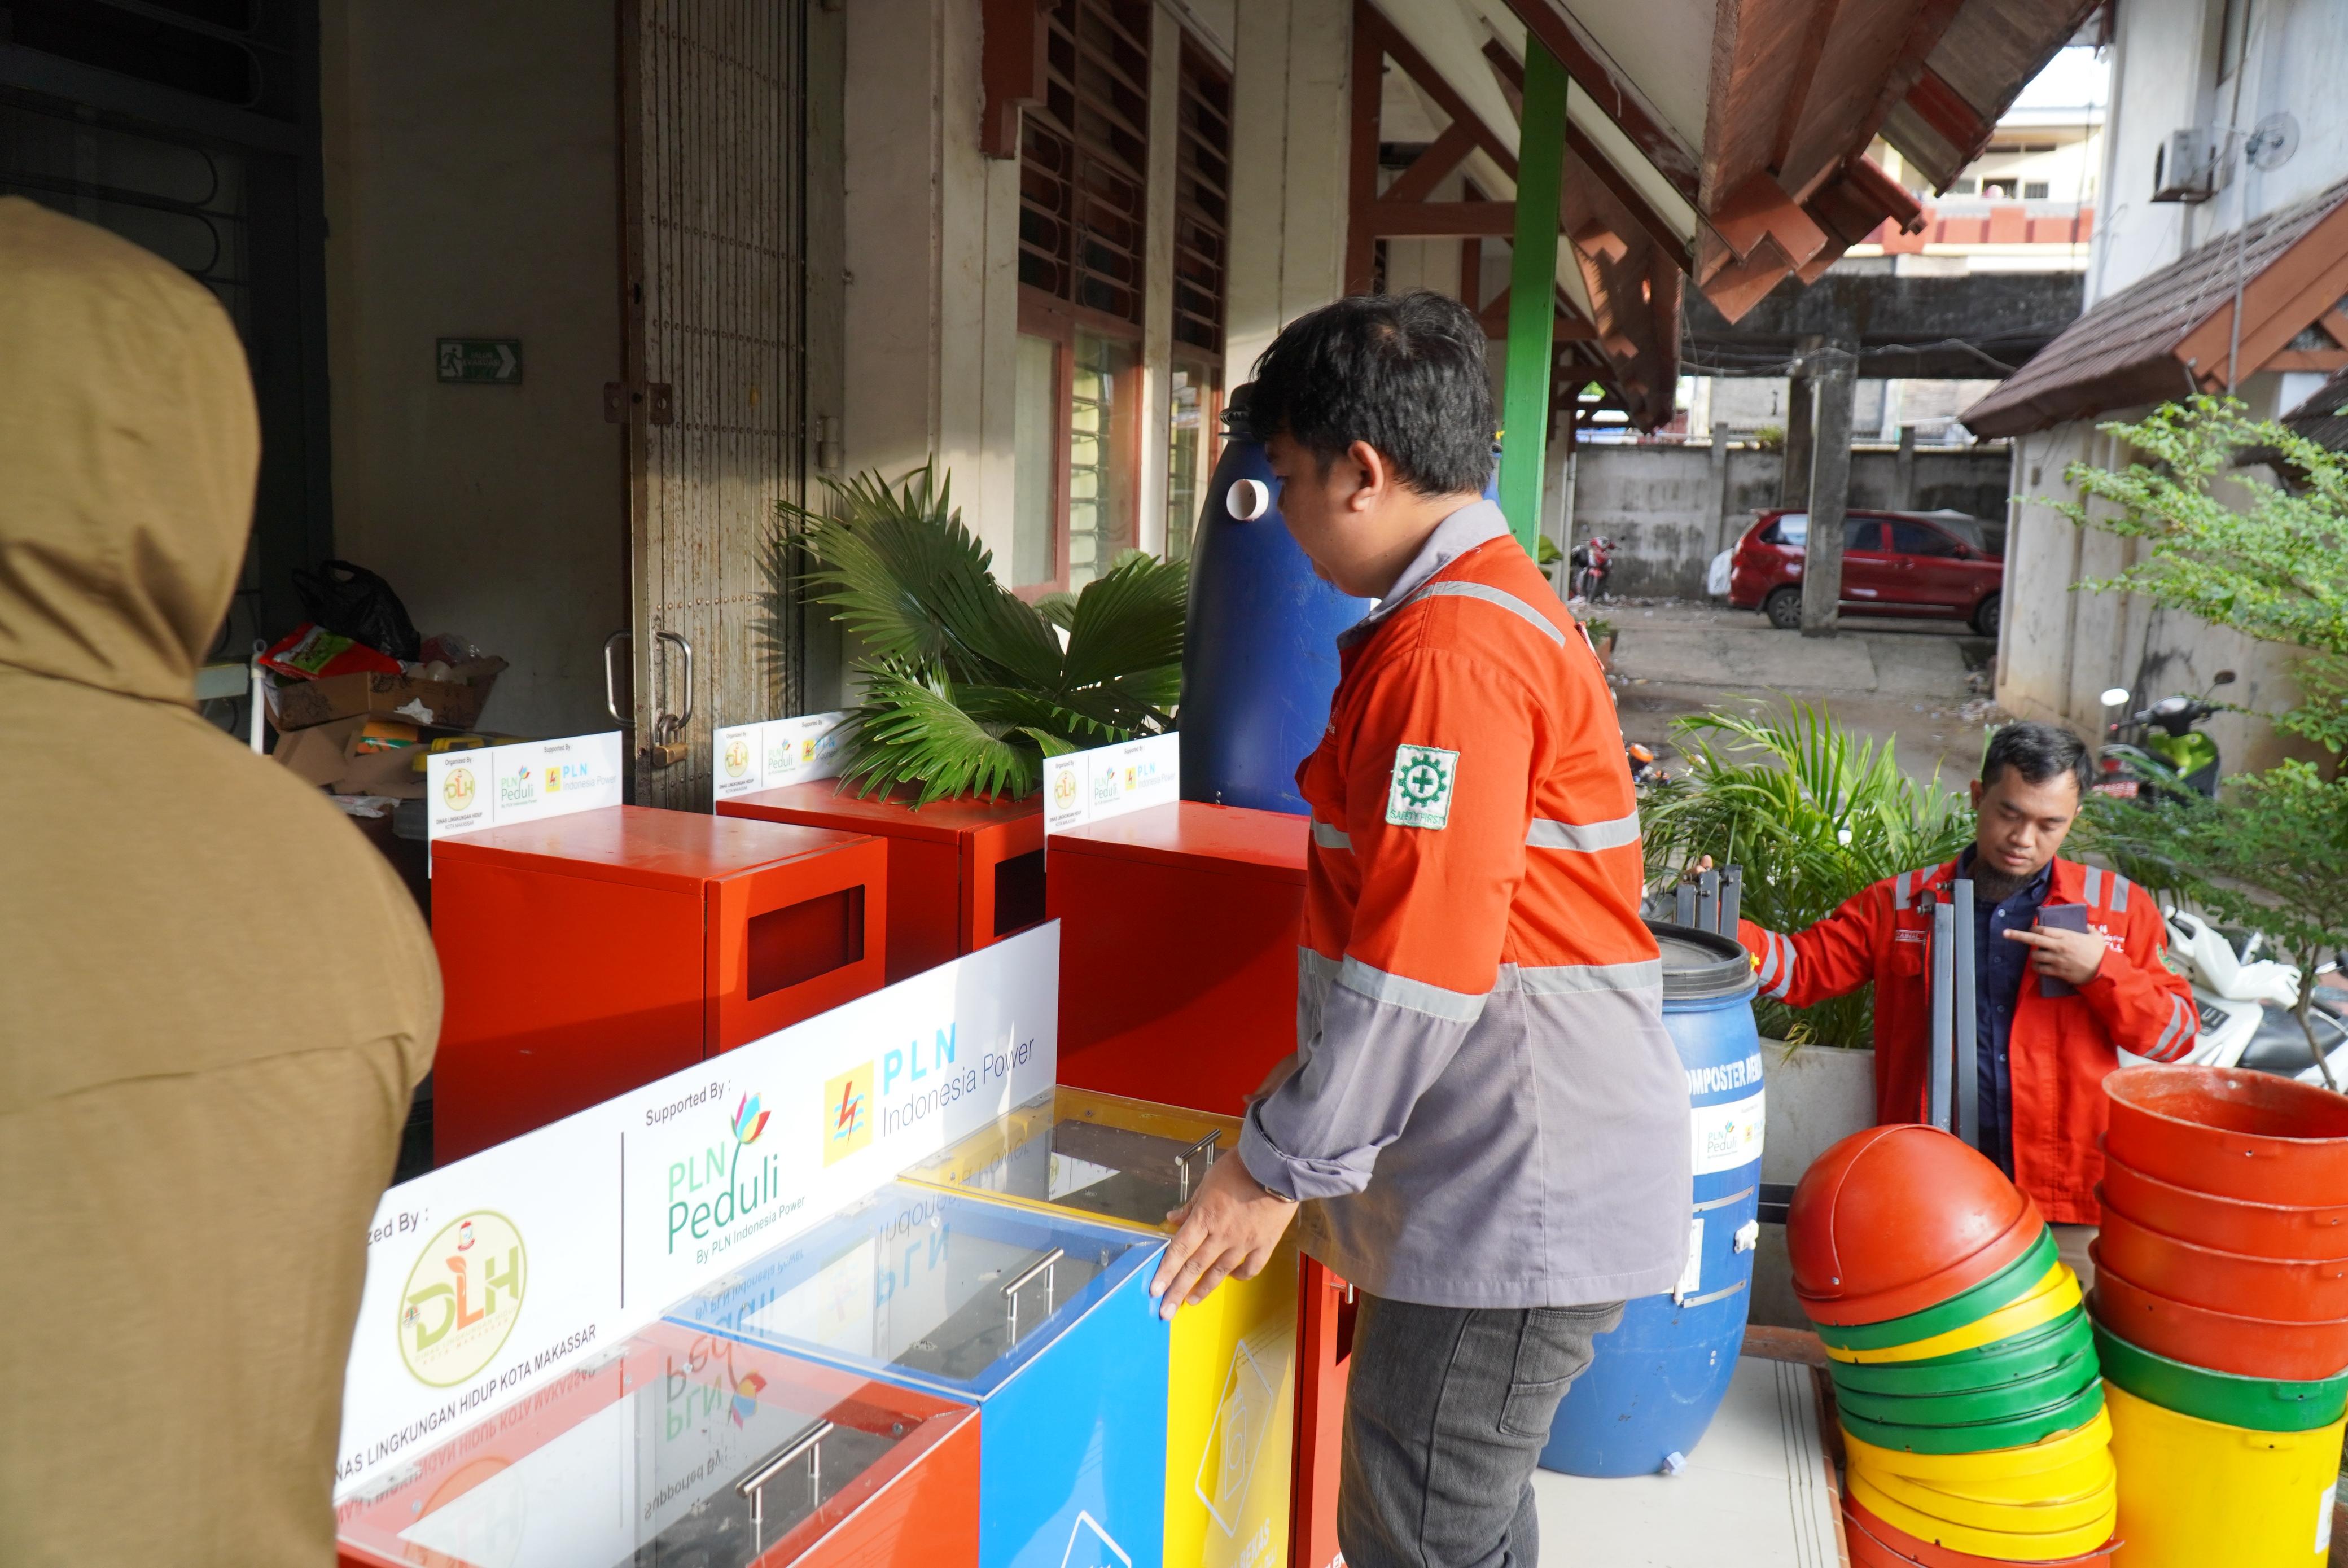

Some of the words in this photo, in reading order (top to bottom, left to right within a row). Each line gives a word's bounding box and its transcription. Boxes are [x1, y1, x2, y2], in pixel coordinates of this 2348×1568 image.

[445, 757, 466, 766] Organized
[544, 744, 564, 754] Supported
[768, 754, 793, 769] Peduli
[501, 777, 518, 789] PLN
[562, 762, 588, 779] PLN
[445, 777, 474, 799] DLH
[501, 782, 533, 801] Peduli
[1094, 782, 1118, 800] Peduli
[1390, 809, 1418, 822] SAFETY
[1420, 811, 1445, 824] FIRST
[883, 1022, 956, 1096] PLN
[883, 1066, 976, 1138] Indonesia
[983, 1037, 1035, 1085] Power
[1685, 1059, 1746, 1096] OMPOSTER
[646, 1086, 706, 1127] Supported
[710, 1081, 725, 1099] By
[1707, 1136, 1737, 1154] Peduli
[668, 1141, 725, 1203] PLN
[668, 1149, 779, 1255] Peduli
[367, 1218, 393, 1246] zed
[398, 1211, 420, 1233] By
[696, 1250, 709, 1265] By
[712, 1234, 731, 1256] PLN
[734, 1213, 777, 1244] Indonesia
[779, 1195, 805, 1219] Power
[406, 1245, 519, 1352] DLH
[335, 1455, 362, 1484] NAS
[368, 1402, 456, 1465] LINGKUNGAN
[459, 1380, 497, 1414] HIDUP
[500, 1361, 532, 1392] KOTA
[535, 1324, 597, 1370] MAKASSAR
